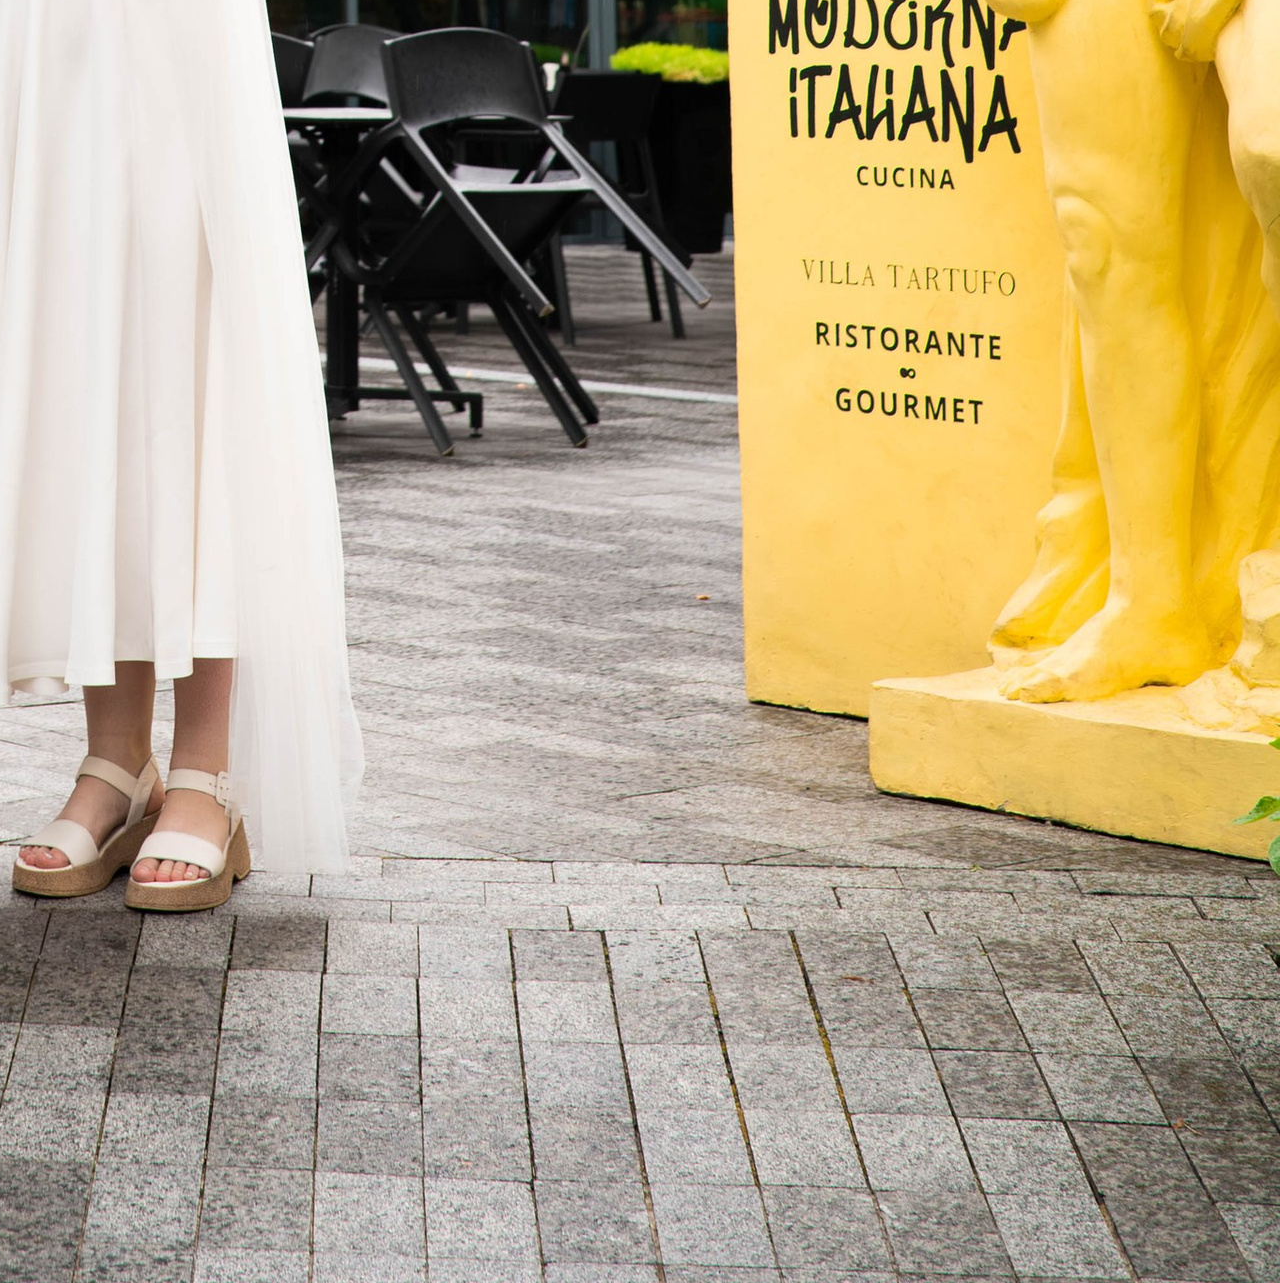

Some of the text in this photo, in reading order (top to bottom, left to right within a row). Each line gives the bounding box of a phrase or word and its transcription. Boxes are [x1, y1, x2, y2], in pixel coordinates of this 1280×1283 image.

[856, 165, 956, 190] CUCINA
[801, 258, 1017, 297] VILLA TARTUFO
[815, 321, 1002, 361] RISTORANTE
[835, 387, 984, 425] GOURMET
